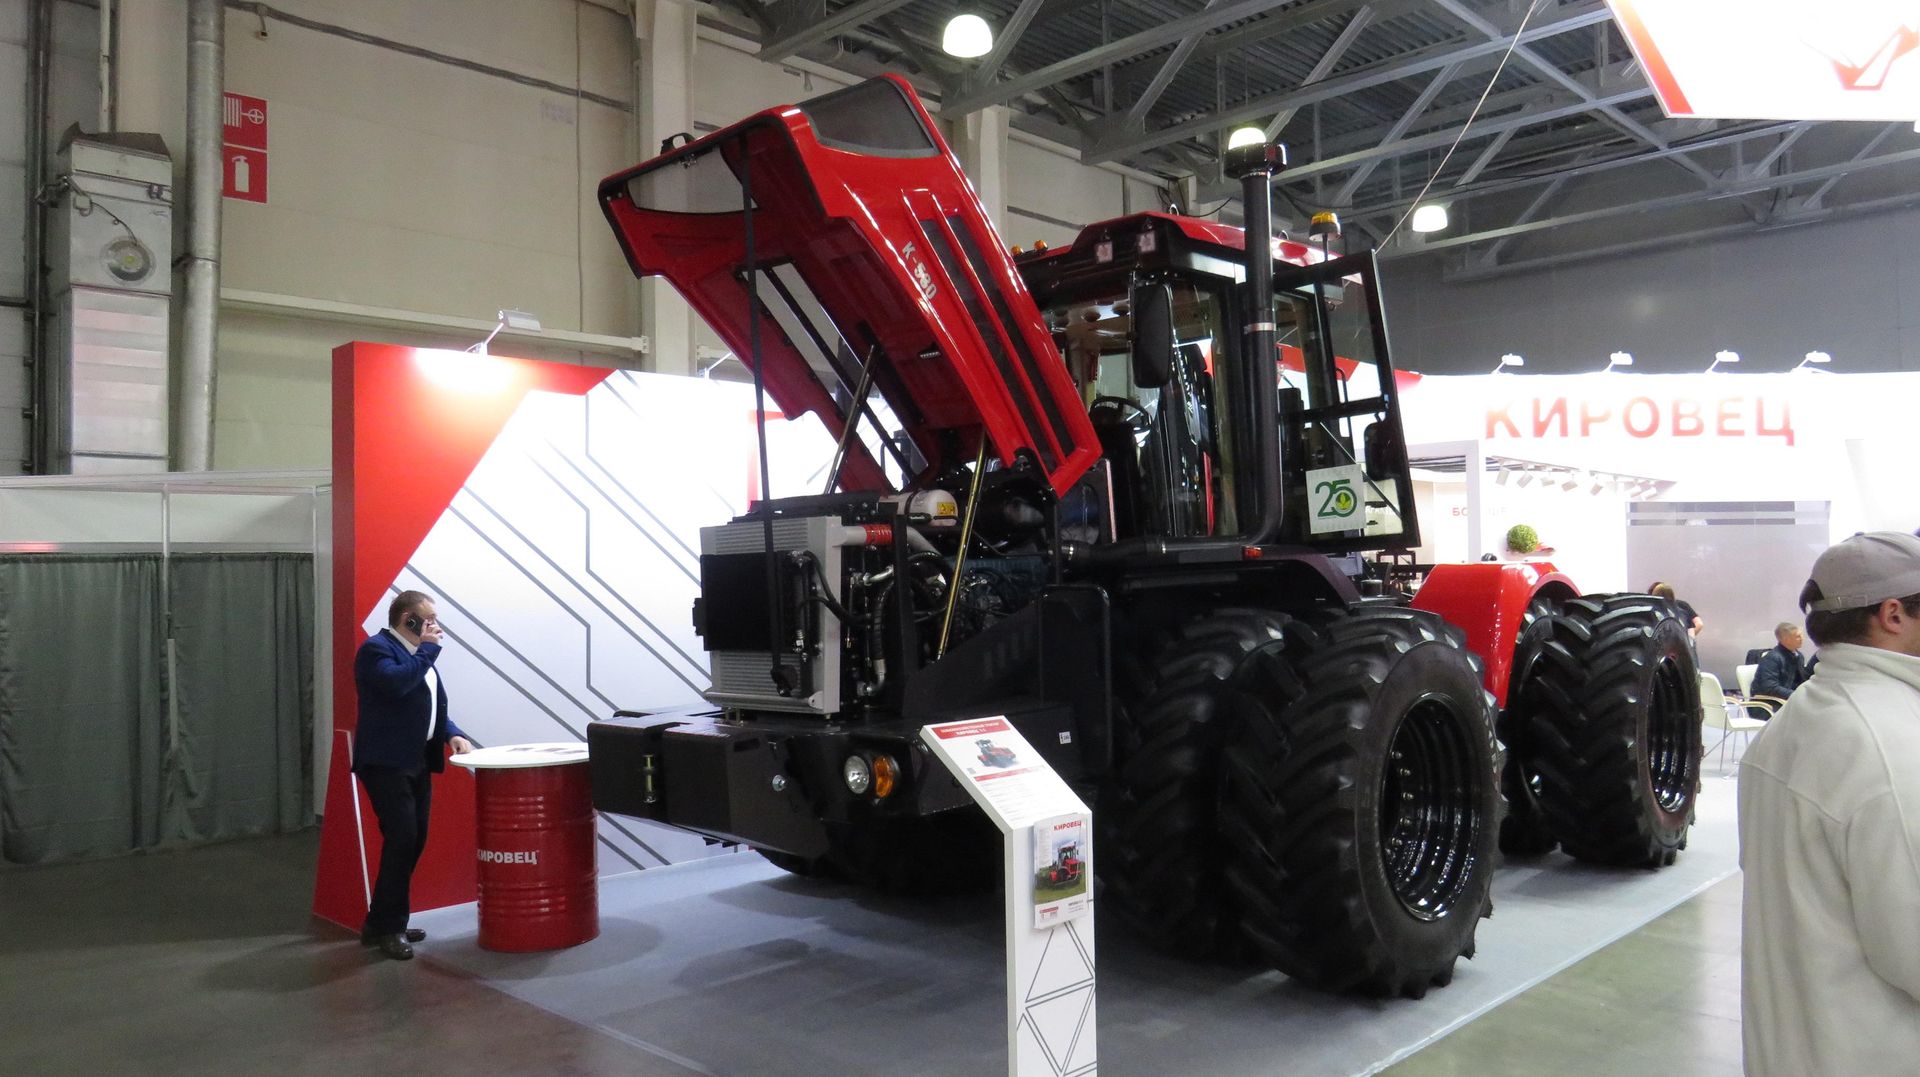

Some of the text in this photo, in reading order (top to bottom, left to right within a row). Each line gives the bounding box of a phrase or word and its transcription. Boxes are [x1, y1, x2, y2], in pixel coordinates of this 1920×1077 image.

[1485, 396, 1794, 446] КИРОВЕЦ
[1315, 479, 1357, 517] 25
[1054, 820, 1081, 830] КИРОВЕЦ
